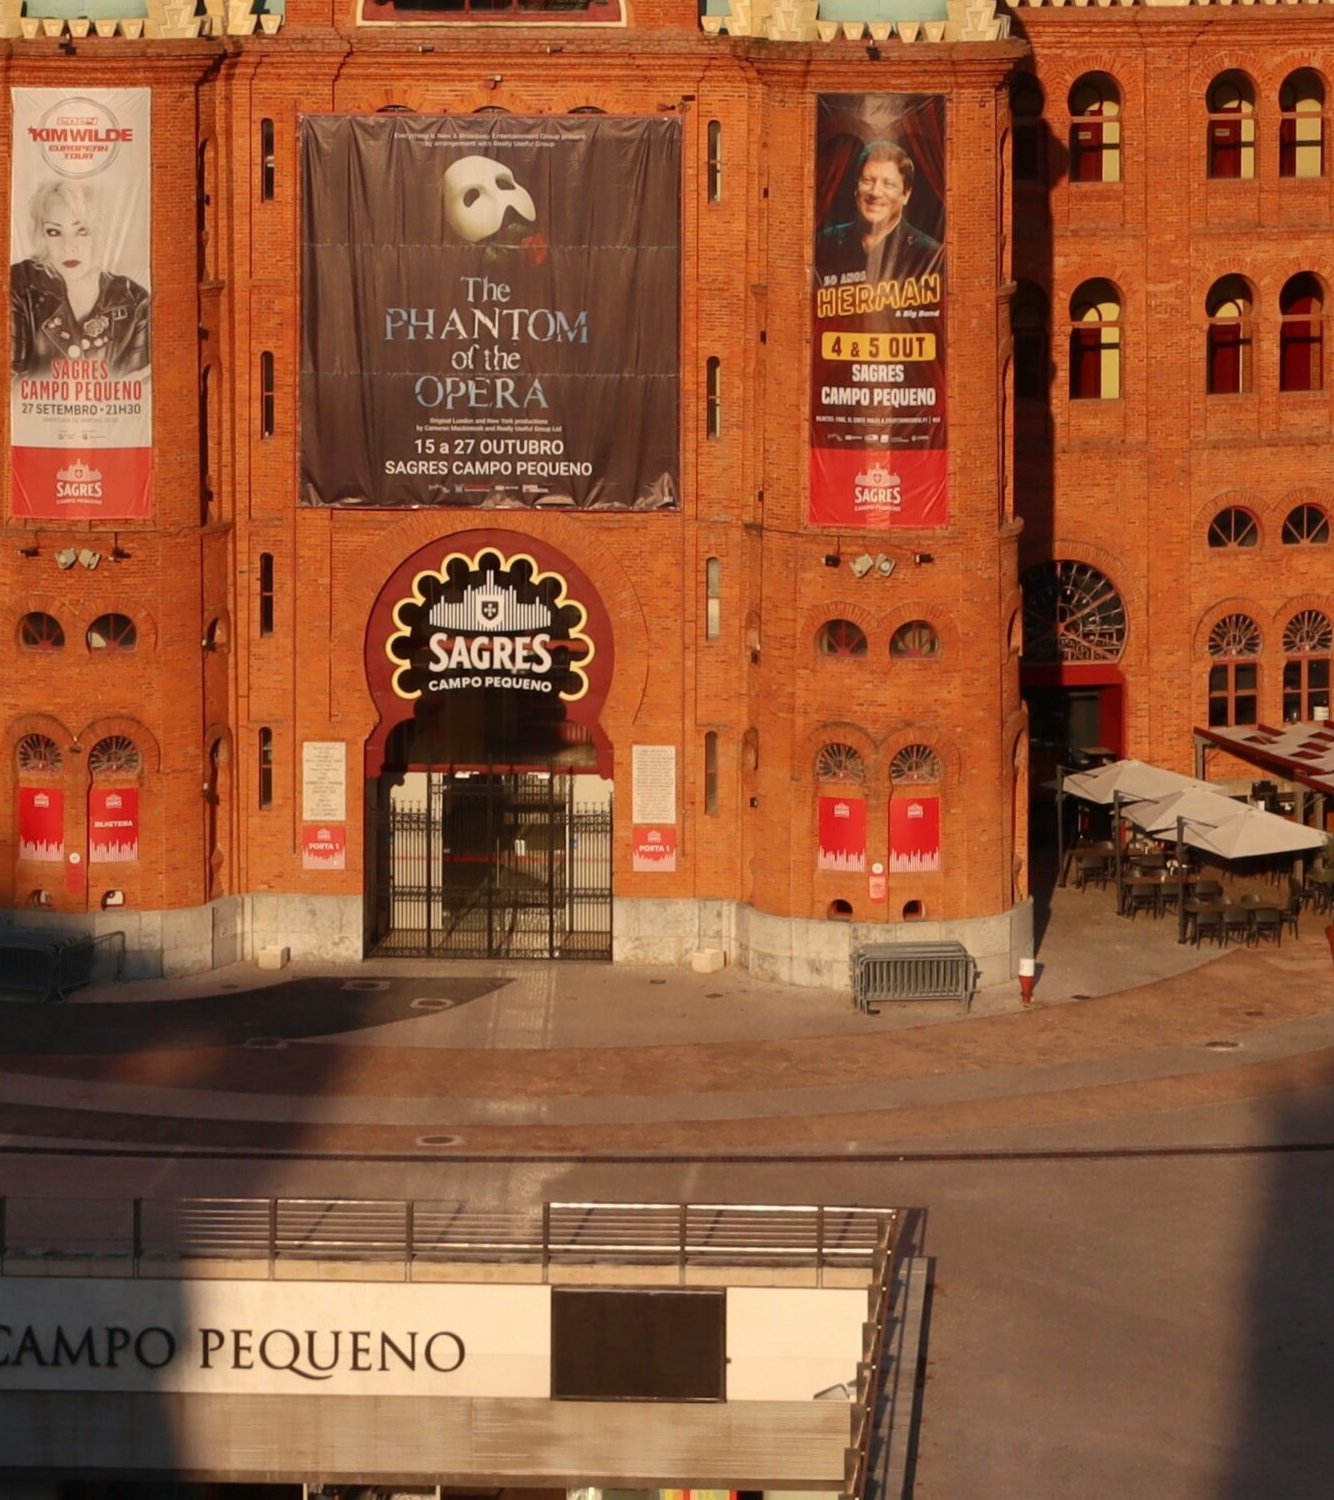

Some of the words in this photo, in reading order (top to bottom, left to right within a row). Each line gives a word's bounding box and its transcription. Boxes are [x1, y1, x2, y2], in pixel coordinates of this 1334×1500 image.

[30, 127, 68, 142] KIM
[69, 128, 133, 142] WILDE
[539, 133, 560, 141] Group
[460, 276, 511, 302] The
[817, 273, 940, 318] HERMAN
[903, 310, 917, 318] Big
[384, 307, 589, 344] PHANTOM
[831, 336, 842, 357] 4
[850, 342, 860, 358] &
[869, 337, 880, 358] 5
[889, 337, 926, 358] OUT
[451, 344, 480, 370] of
[484, 344, 521, 371] the
[52, 359, 109, 380] SAGRES
[852, 364, 905, 382] SAGRES
[21, 380, 70, 401] CAMPO
[75, 380, 142, 402] PEQUENO
[415, 375, 549, 410] OPERA
[821, 386, 870, 406] CAMPO
[873, 387, 936, 408] PEQUENO
[22, 403, 34, 414] 27
[36, 404, 98, 416] SETEMBRO
[106, 403, 141, 415] 21H30
[497, 425, 514, 433] Really
[534, 425, 551, 433] Group
[414, 439, 435, 454] 15
[439, 443, 449, 454] a
[454, 440, 475, 454] 27
[480, 440, 564, 455] OUTUBRO
[385, 461, 448, 475] SAGRES
[452, 461, 512, 475] CAMPO
[516, 462, 593, 477] PEQUENO
[56, 481, 103, 497] SAGRES
[854, 486, 901, 504] SAGRES
[428, 632, 553, 674] SAGRES
[428, 676, 483, 692] CAMPO
[484, 676, 553, 693] PEQUENO
[308, 842, 334, 850] PORTA
[638, 844, 664, 852] PORTA
[199, 1328, 466, 1381] PEQUENO
